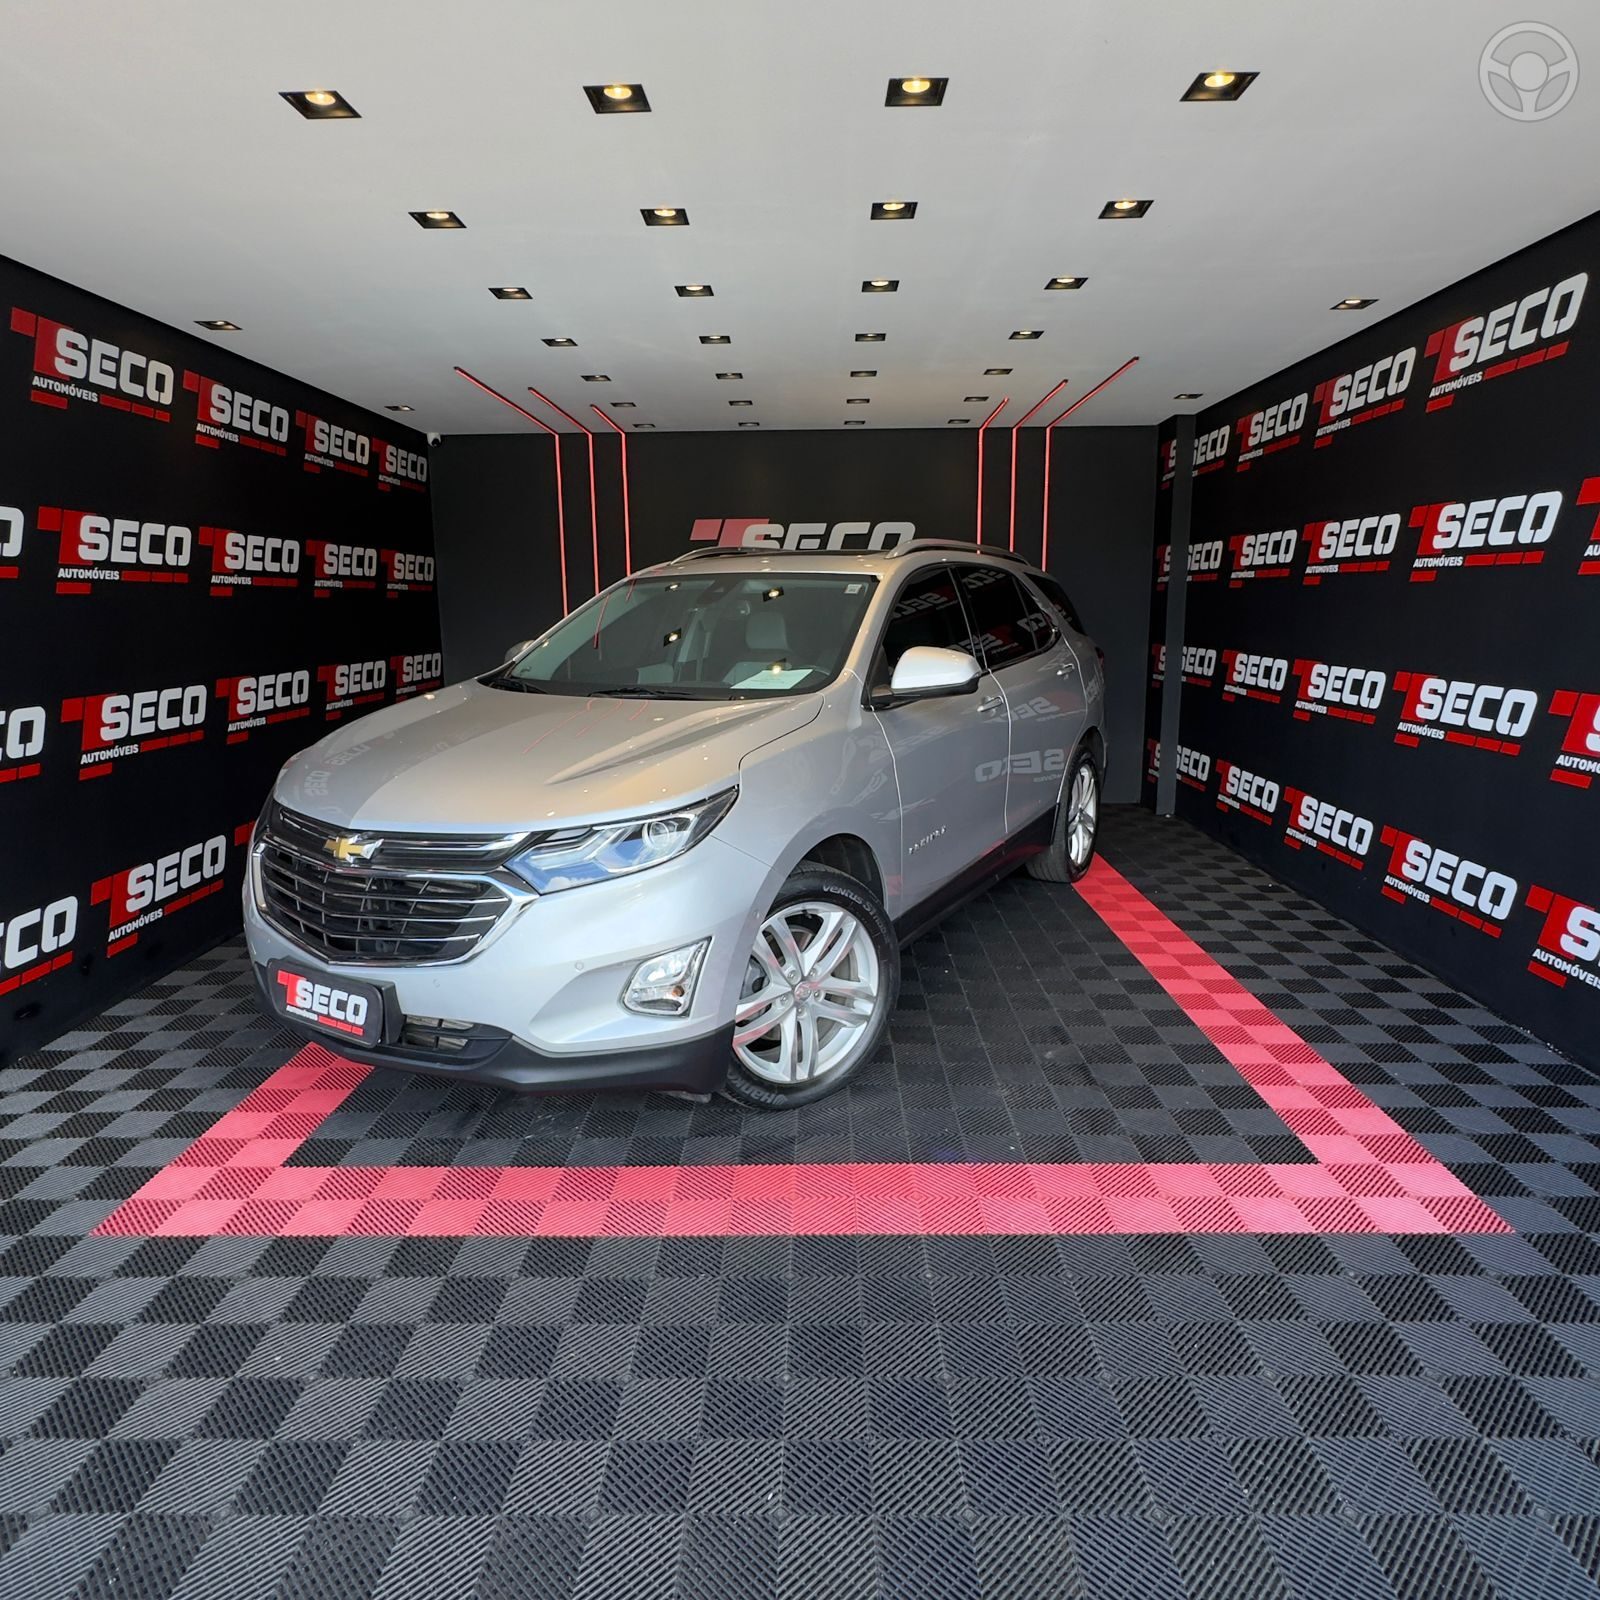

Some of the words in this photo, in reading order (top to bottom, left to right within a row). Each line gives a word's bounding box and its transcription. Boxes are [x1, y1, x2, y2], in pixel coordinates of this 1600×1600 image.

[32, 375, 98, 402] AUTOMÓVEIS
[1429, 372, 1482, 398] AUTOMÓVEIS
[197, 423, 239, 442] AUTOMÓVEIS
[1413, 555, 1464, 568] AUTOMÓVEIS
[58, 567, 119, 580] AUTOMÓVEIS
[1397, 722, 1445, 740] AUTOMÓVEIS
[81, 744, 138, 764] AUTOMÓVEIS
[1556, 755, 1600, 774] AUTOM
[1385, 875, 1430, 903] AUTOMÓVEIS
[108, 908, 163, 942] AUTOMÓVEIS
